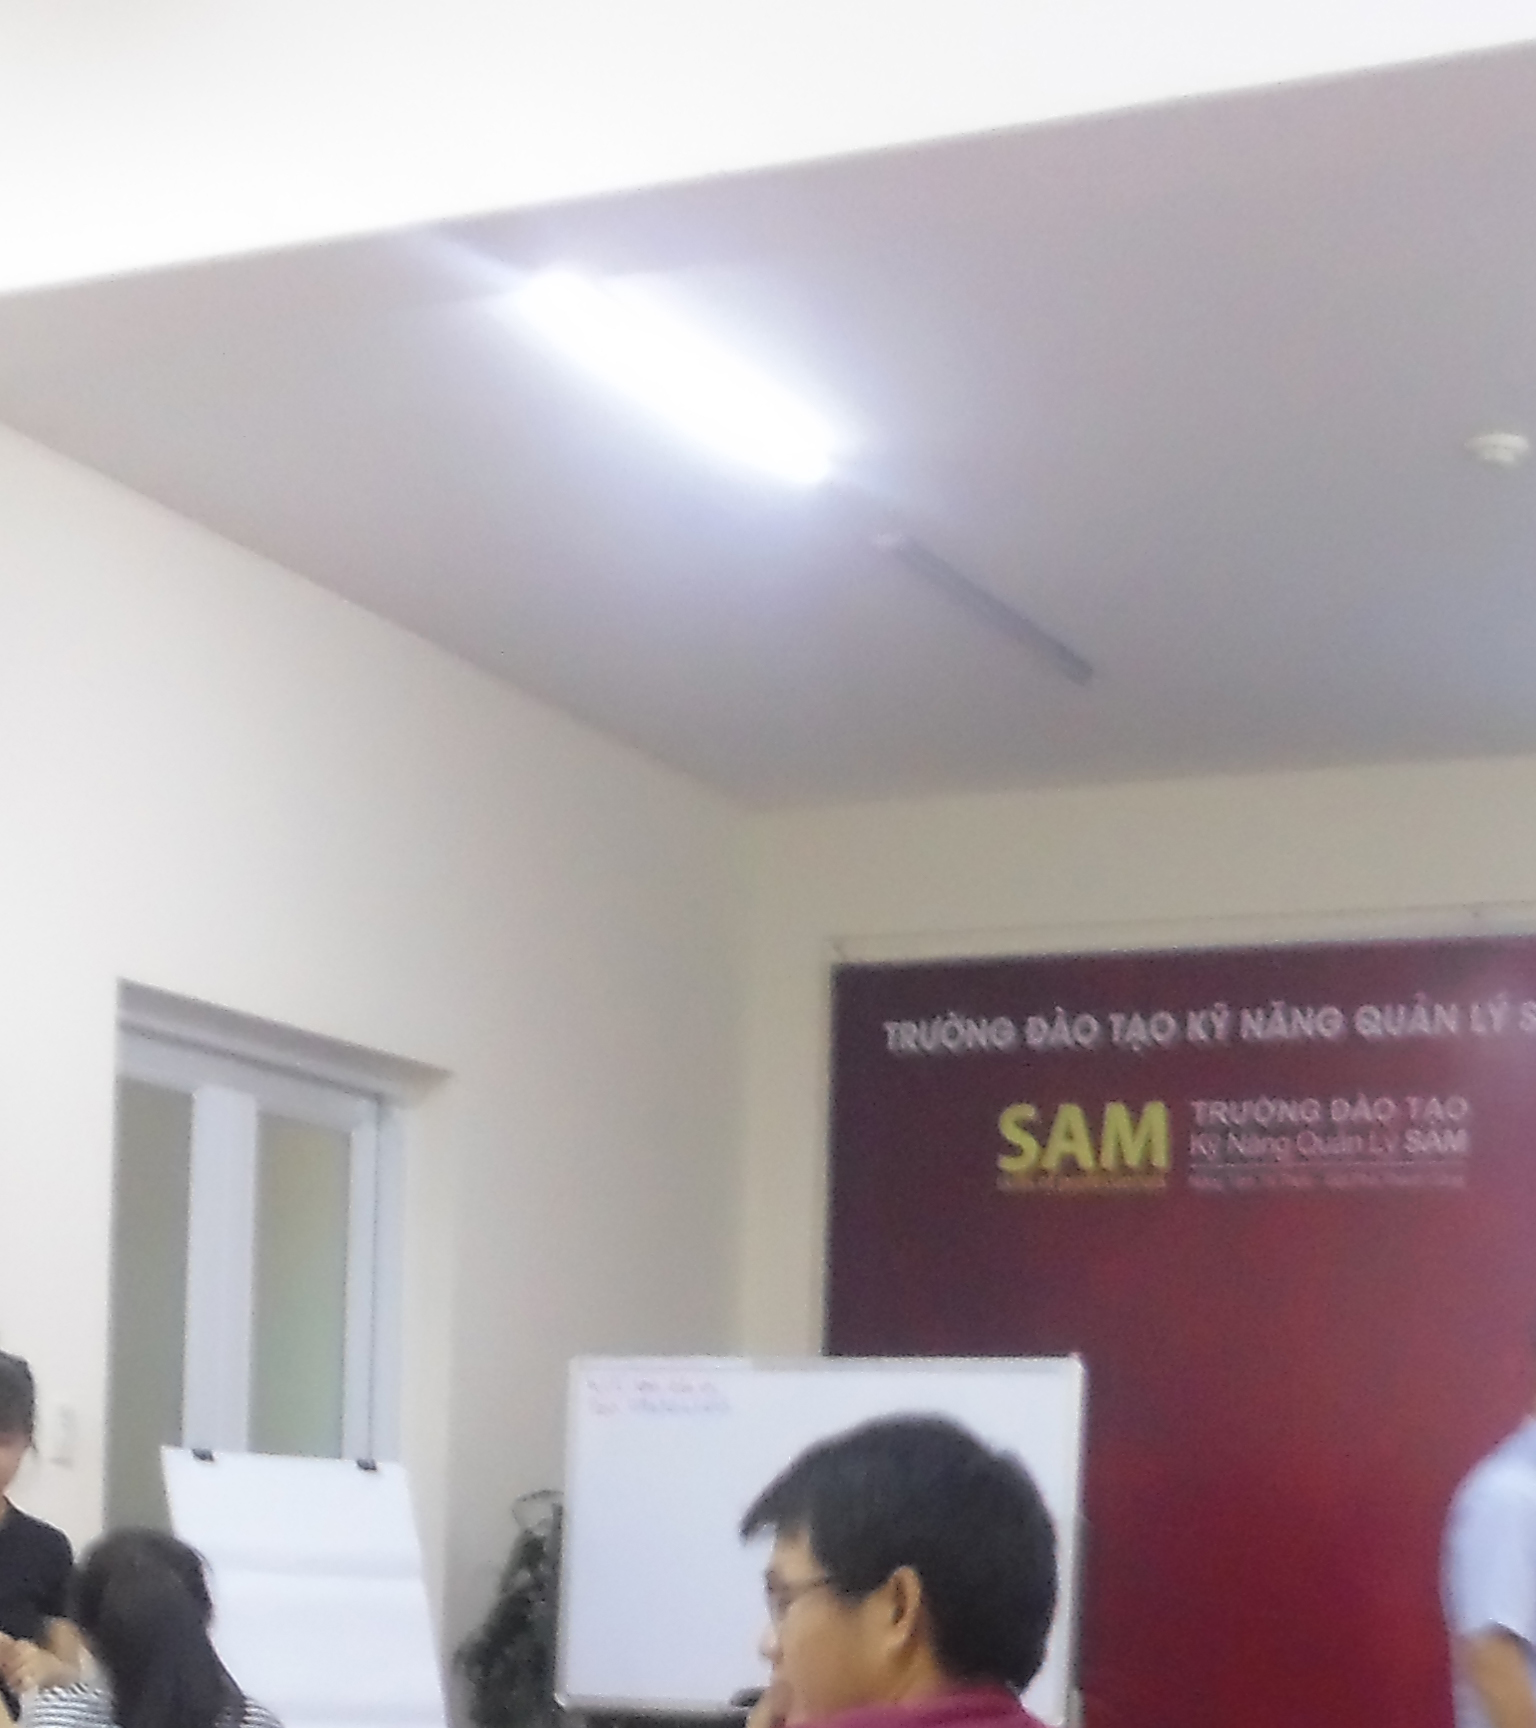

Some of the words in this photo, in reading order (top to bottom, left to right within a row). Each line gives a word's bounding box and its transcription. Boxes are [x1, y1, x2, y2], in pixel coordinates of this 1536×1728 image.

[1109, 1009, 1177, 1051] TẠO
[997, 1100, 1169, 1173] SAM
[1404, 1128, 1468, 1153] SAM
